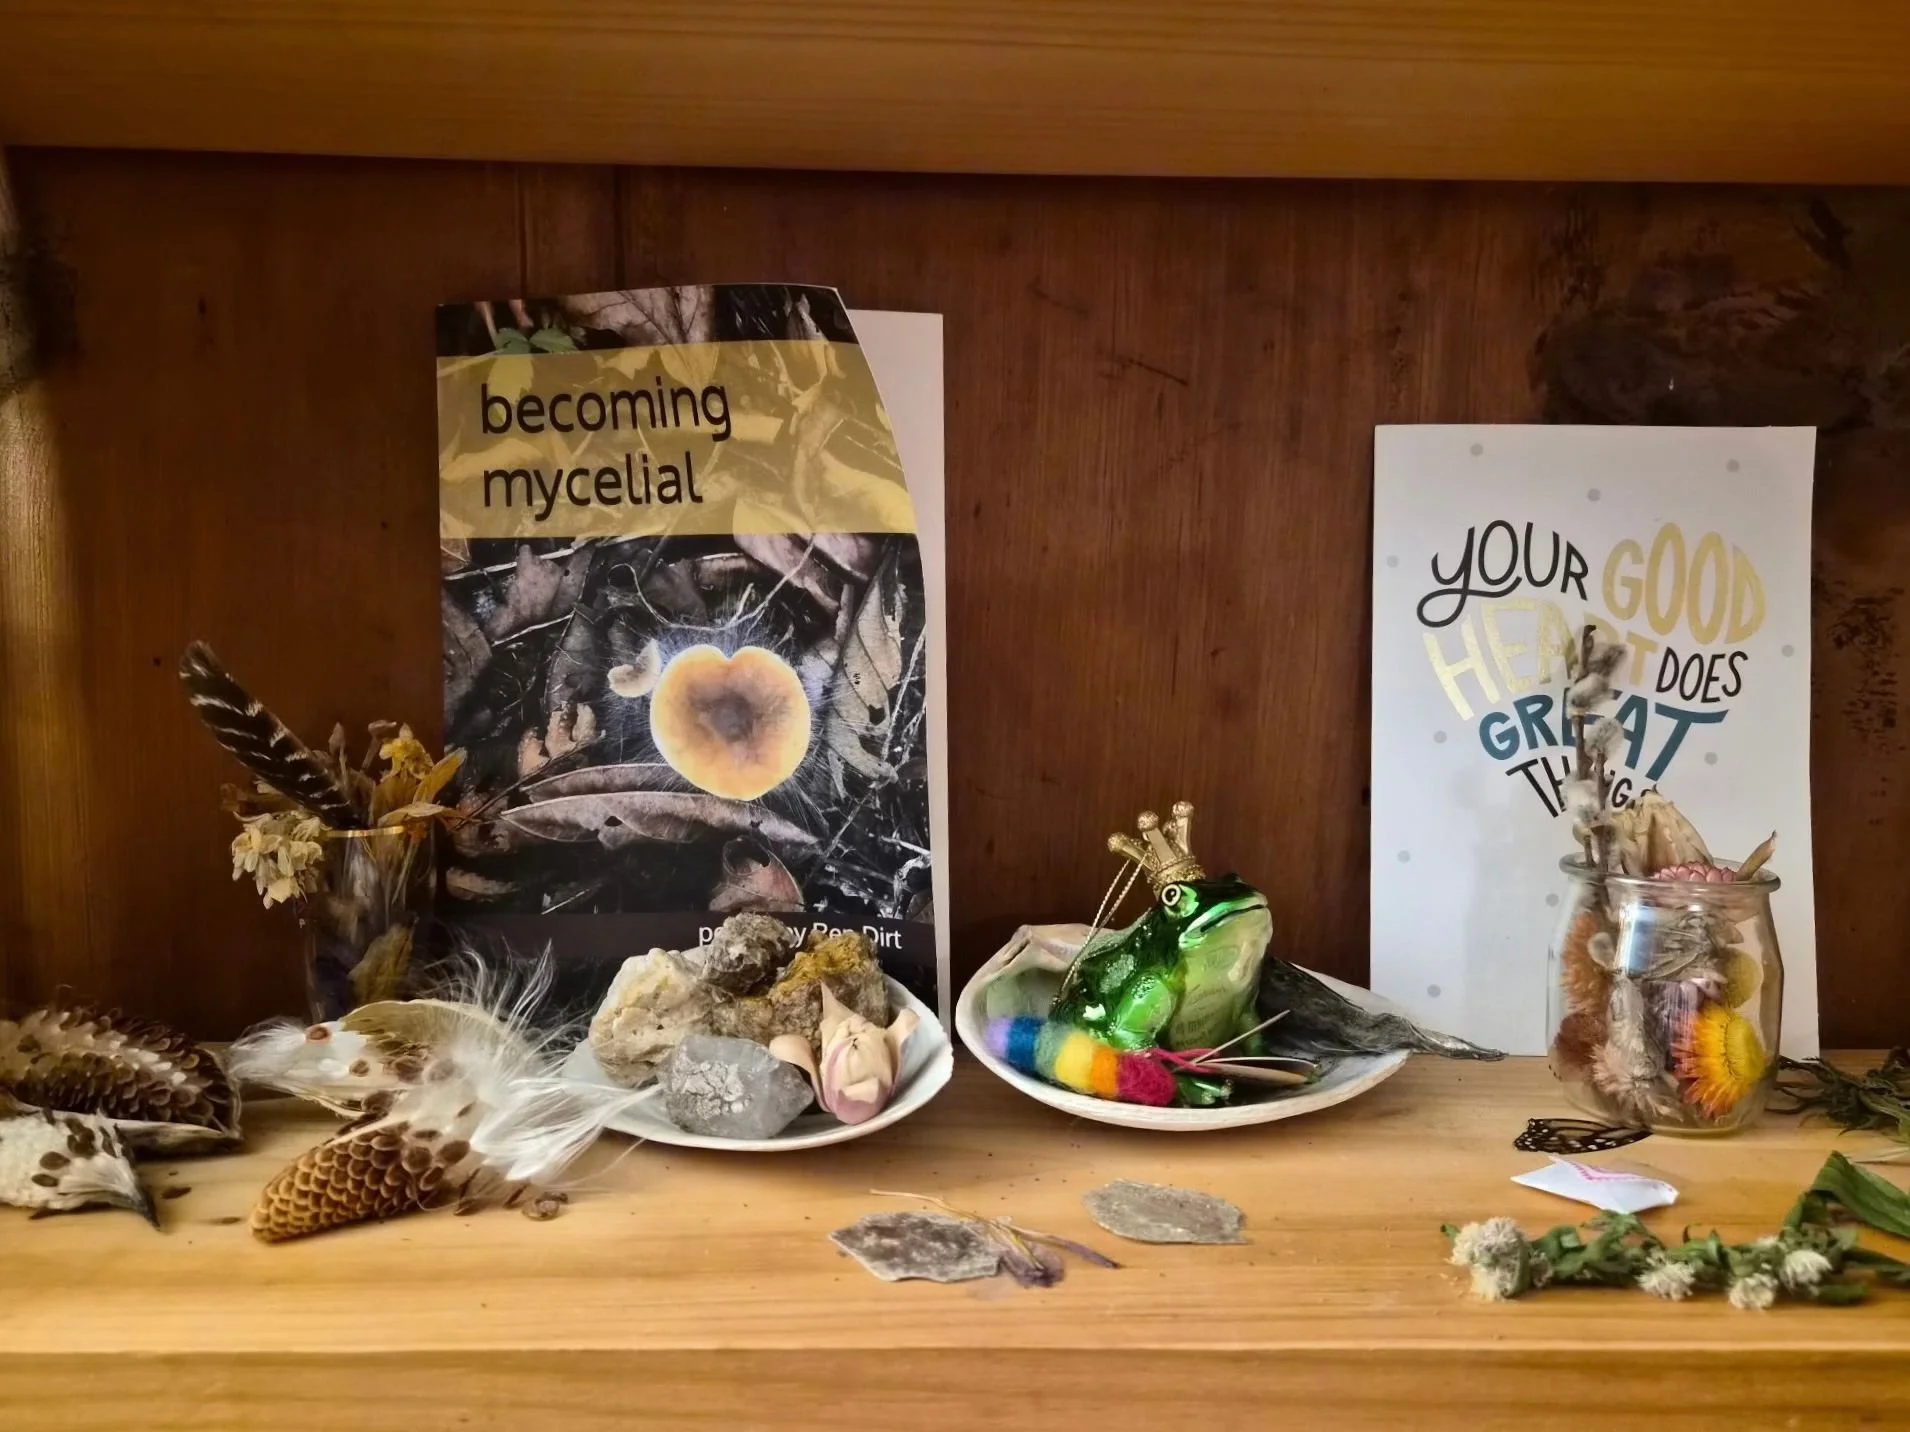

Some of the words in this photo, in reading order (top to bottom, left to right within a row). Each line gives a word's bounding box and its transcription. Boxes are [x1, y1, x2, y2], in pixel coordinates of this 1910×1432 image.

[480, 376, 732, 442] becoming
[483, 451, 703, 522] mycelial
[1416, 519, 1589, 628] YOUR
[1602, 522, 1767, 645] GOOD
[1655, 646, 1749, 704] DOES
